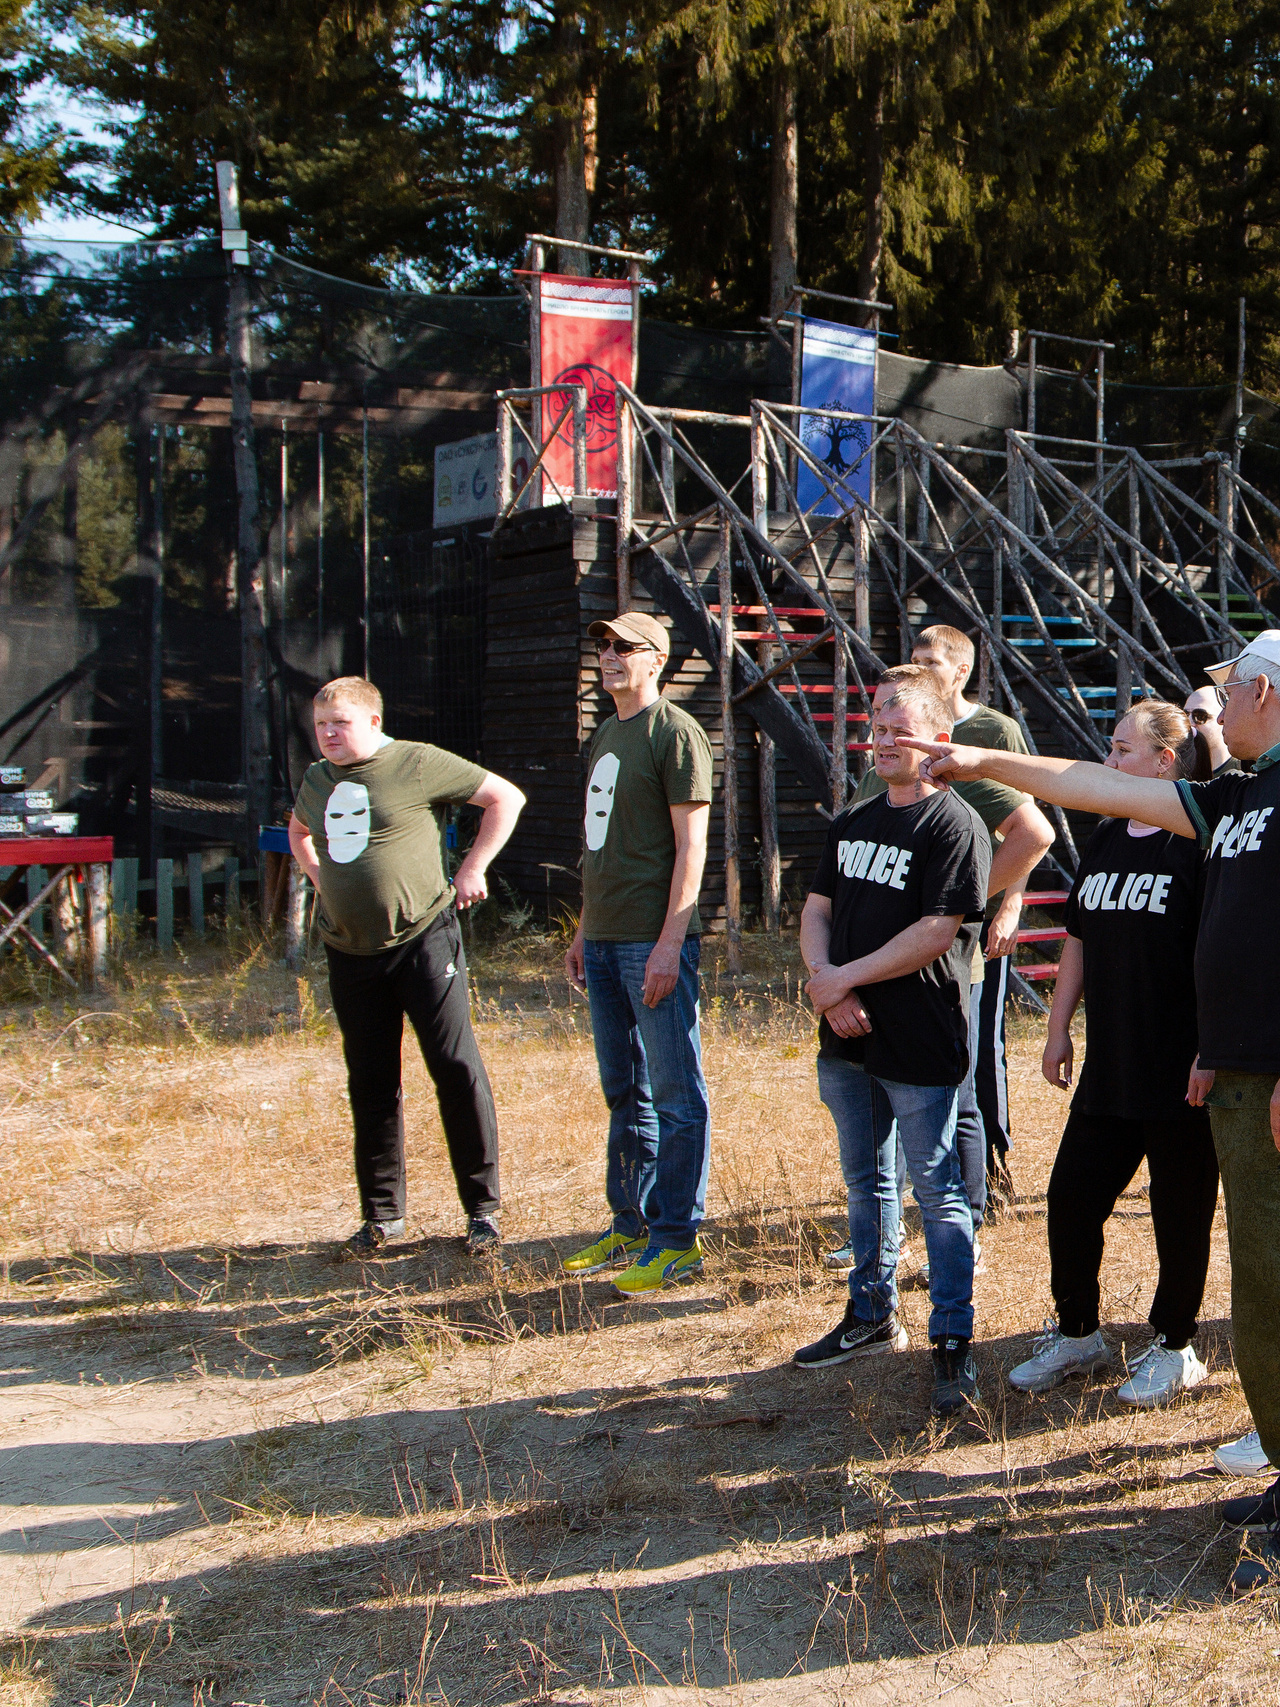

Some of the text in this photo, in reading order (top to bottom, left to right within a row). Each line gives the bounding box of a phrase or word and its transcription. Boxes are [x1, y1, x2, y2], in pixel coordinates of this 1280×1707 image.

[837, 840, 913, 890] POLICE
[1078, 872, 1173, 914] POLICE
[845, 1325, 875, 1342] NIKE
